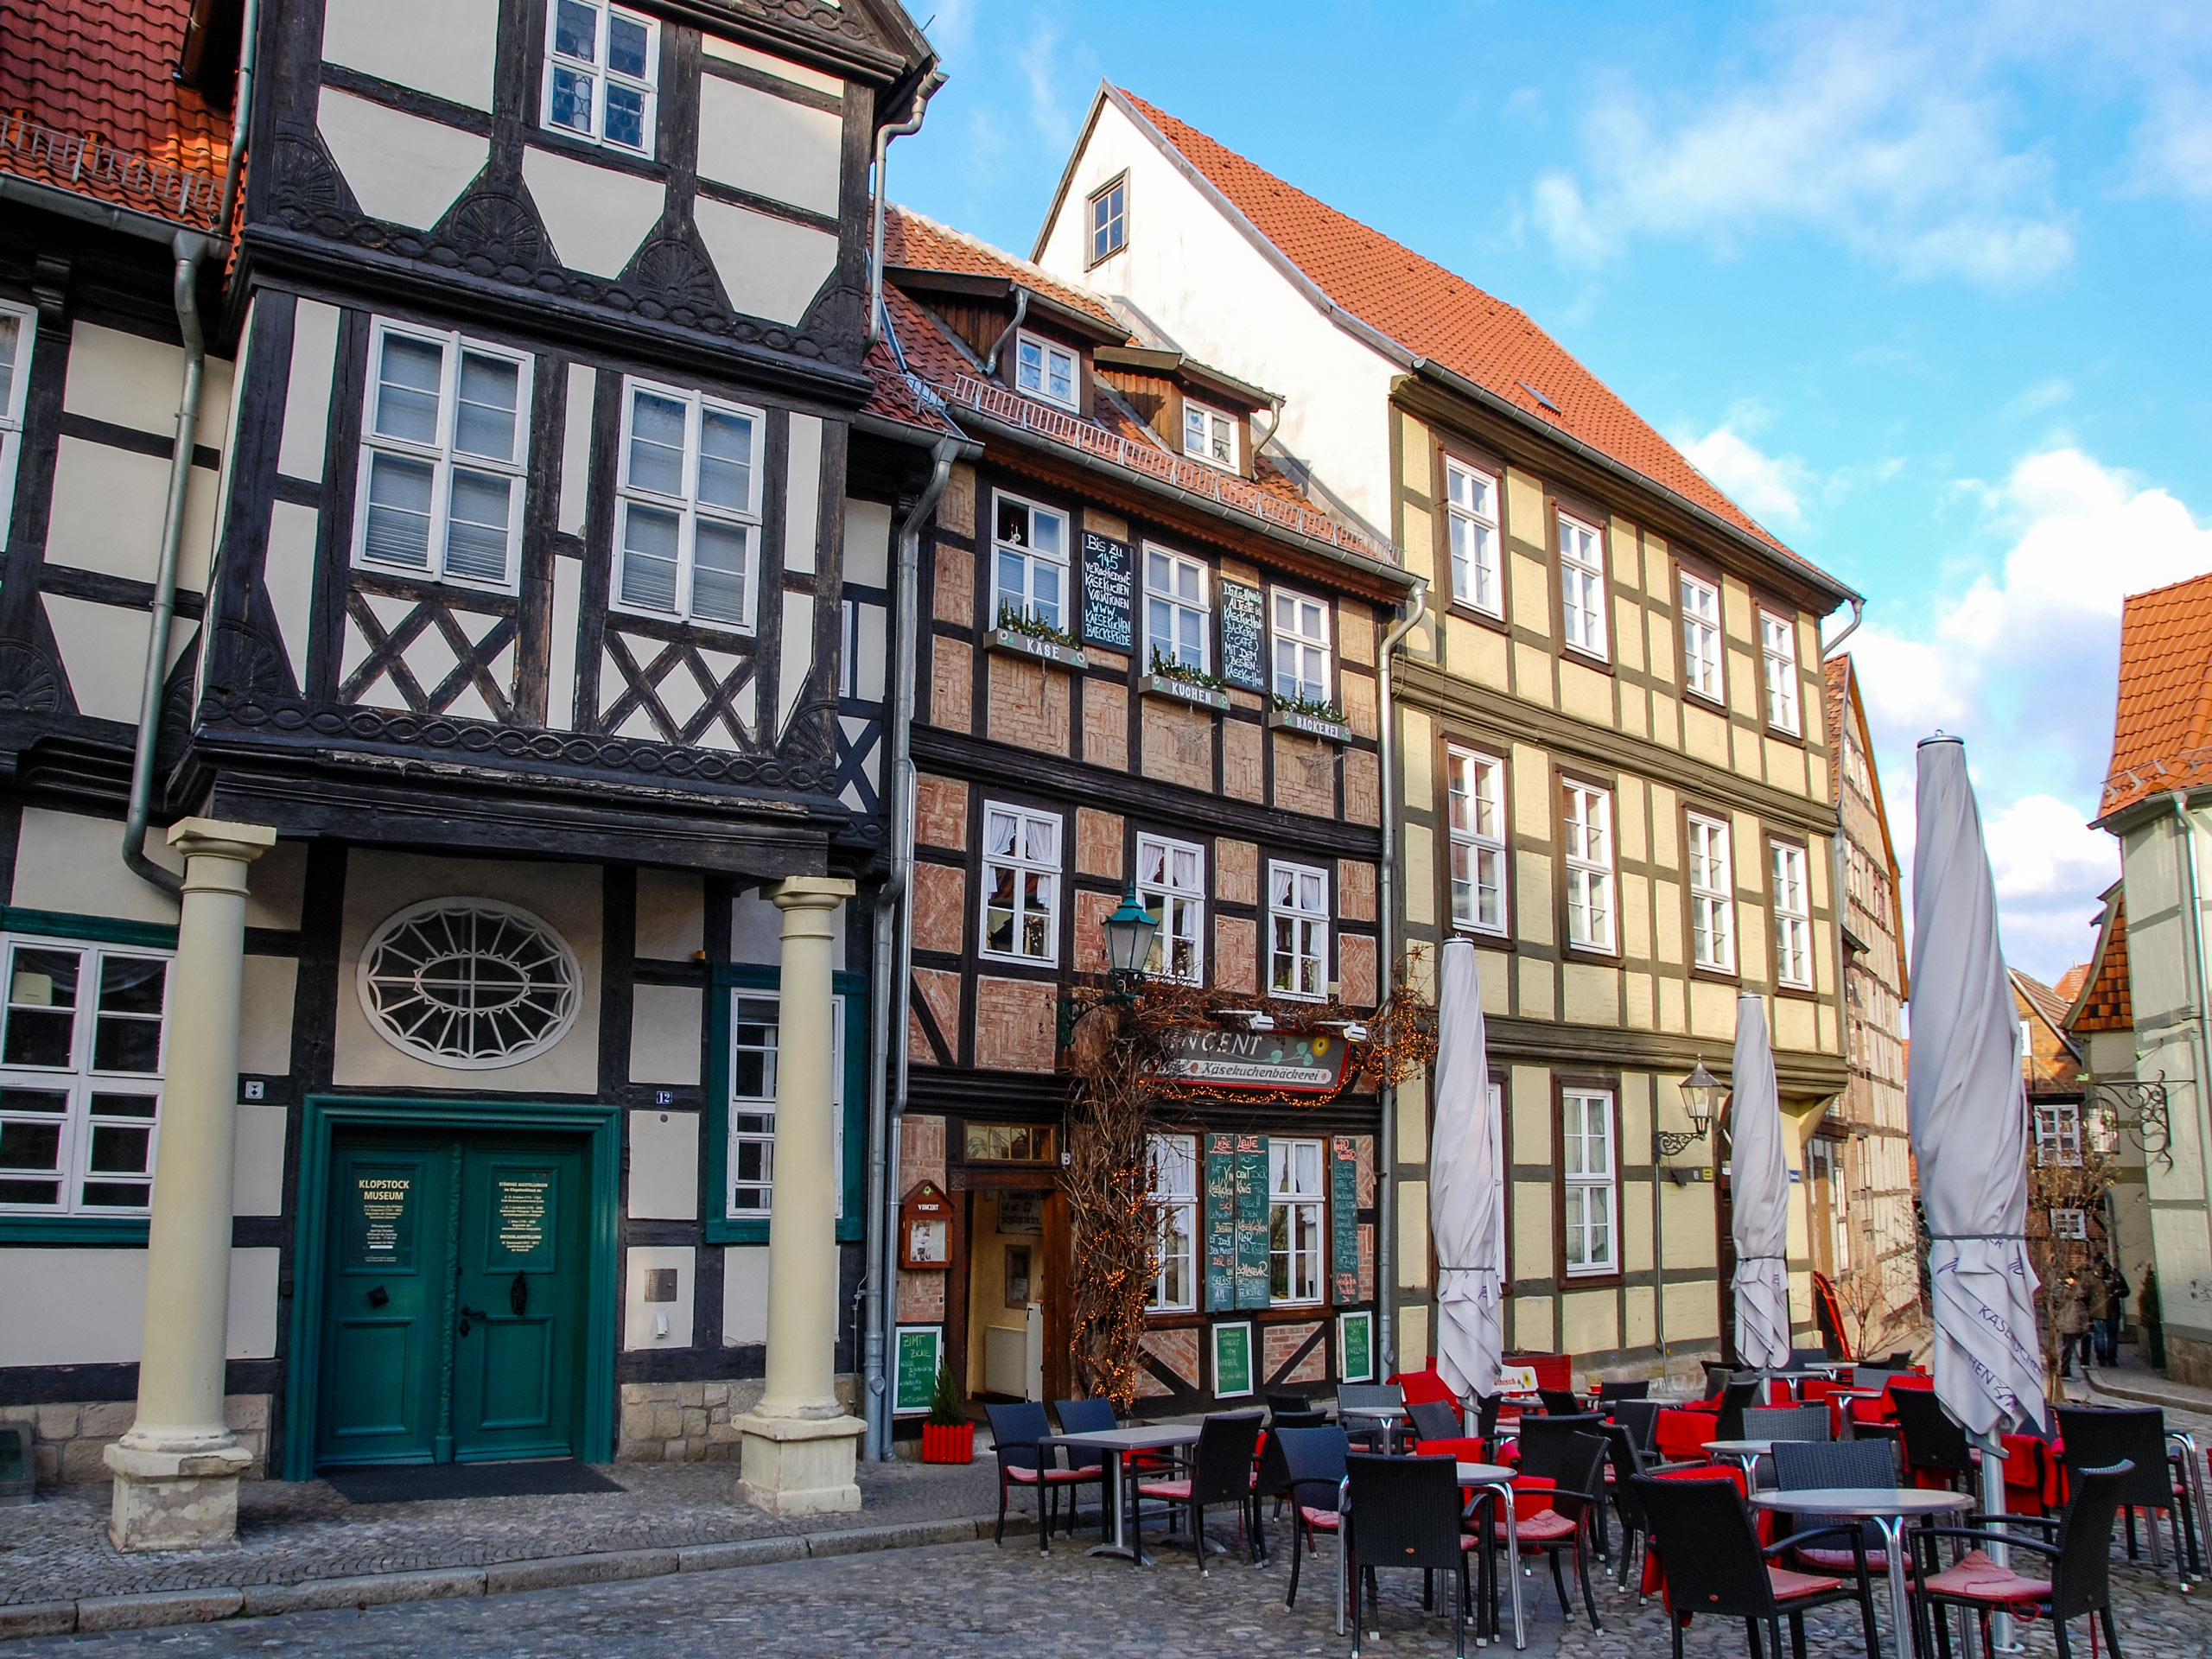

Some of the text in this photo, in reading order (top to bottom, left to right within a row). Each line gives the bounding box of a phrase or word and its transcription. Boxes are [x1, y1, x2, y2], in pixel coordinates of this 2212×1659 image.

[1097, 552, 1118, 569] 145
[1172, 682, 1211, 704] KUCHEN
[1201, 1062, 1320, 1081] Käsekuchenbäckerei
[659, 1092, 670, 1103] 12
[359, 1179, 410, 1189] KLOPSTOCK
[364, 1191, 404, 1200] MUSEUM
[903, 1335, 925, 1347] ZIMT
